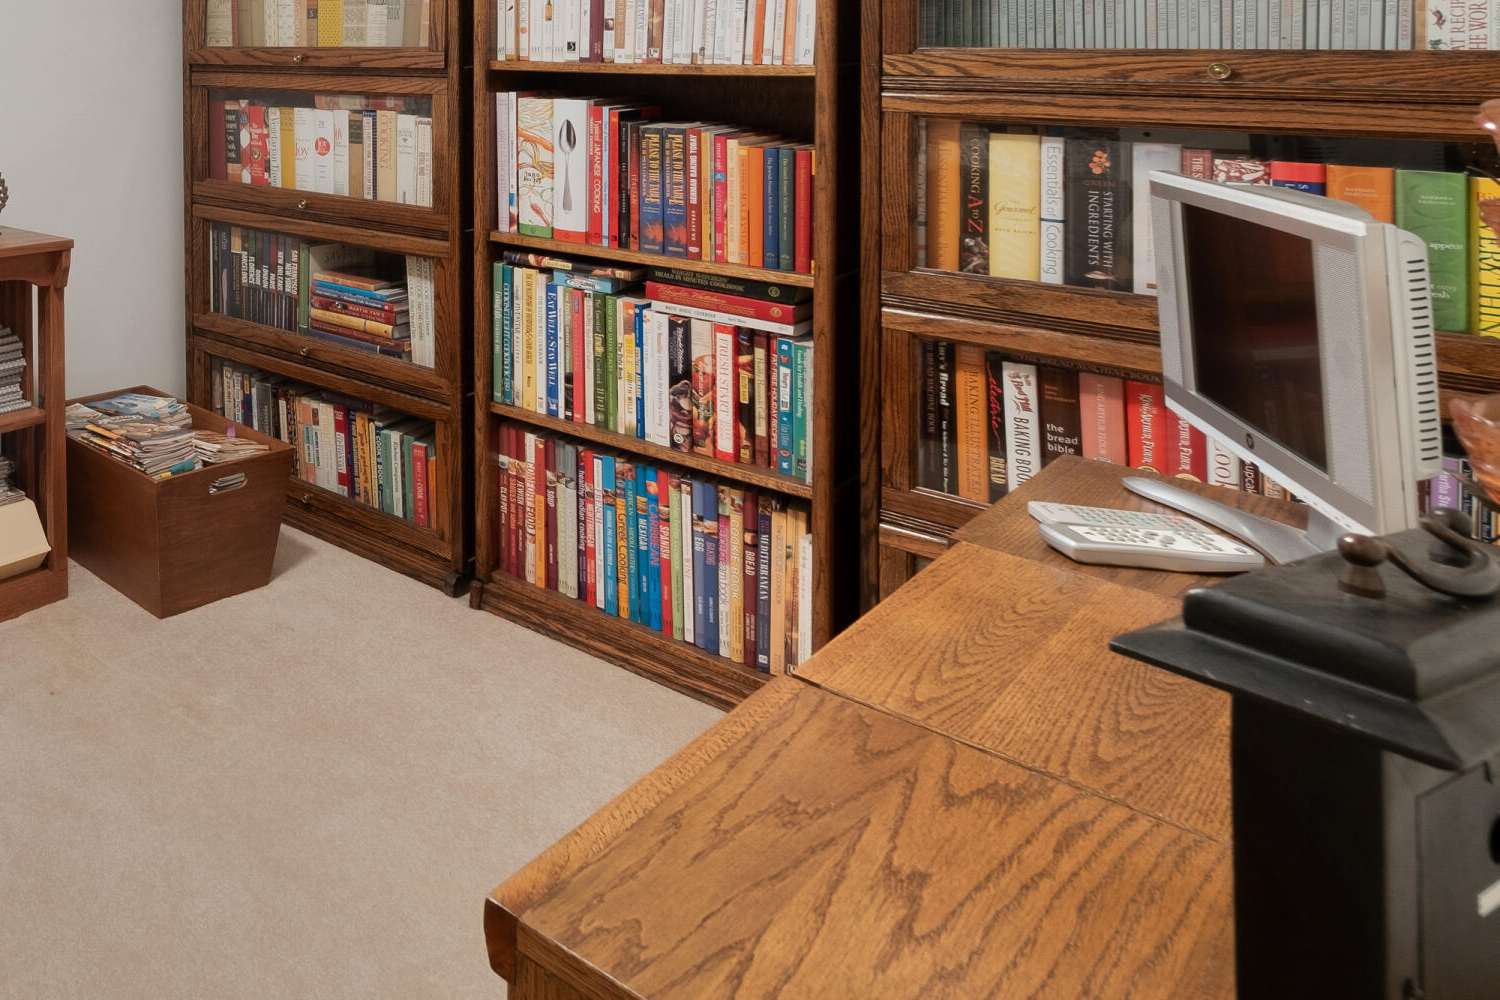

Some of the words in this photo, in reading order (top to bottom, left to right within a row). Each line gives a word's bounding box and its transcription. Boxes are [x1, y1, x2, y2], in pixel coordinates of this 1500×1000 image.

[380, 115, 388, 169] COOKING
[593, 144, 601, 176] JAPANESE
[971, 138, 980, 193] COOKING
[1047, 146, 1059, 206] Essentials
[968, 195, 983, 208] A
[1102, 191, 1114, 238] STARTING
[968, 218, 983, 233] Z
[1088, 190, 1099, 265] INGREDIENTS
[1043, 225, 1059, 275] Cooking
[1102, 241, 1113, 268] WITH
[547, 292, 556, 309] EAT
[548, 311, 556, 335] WELL
[720, 338, 729, 377] FRESH
[548, 362, 556, 387] WELL
[939, 372, 949, 406] Bread
[720, 379, 729, 416] START
[968, 371, 980, 414] BAKING
[1014, 417, 1030, 455] BAKING
[1046, 423, 1064, 433] the
[1047, 432, 1079, 445] bread
[971, 417, 981, 495] ILLUSTRATED
[1047, 443, 1075, 455] bible
[1141, 437, 1153, 463] FLOUR
[990, 456, 1006, 485] BREAD
[547, 489, 555, 507] SOUP
[618, 513, 627, 542] Greek
[638, 518, 648, 551] MEXICAN
[649, 503, 659, 566] CARIBBEAN
[660, 524, 670, 559] SPANISH
[694, 536, 704, 552] EGG
[731, 519, 740, 563] COOKIE
[617, 545, 628, 586] Cooking
[745, 550, 755, 576] BREAD
[760, 534, 770, 600] MEDITERRANEAN
[732, 566, 740, 599] BOOK
